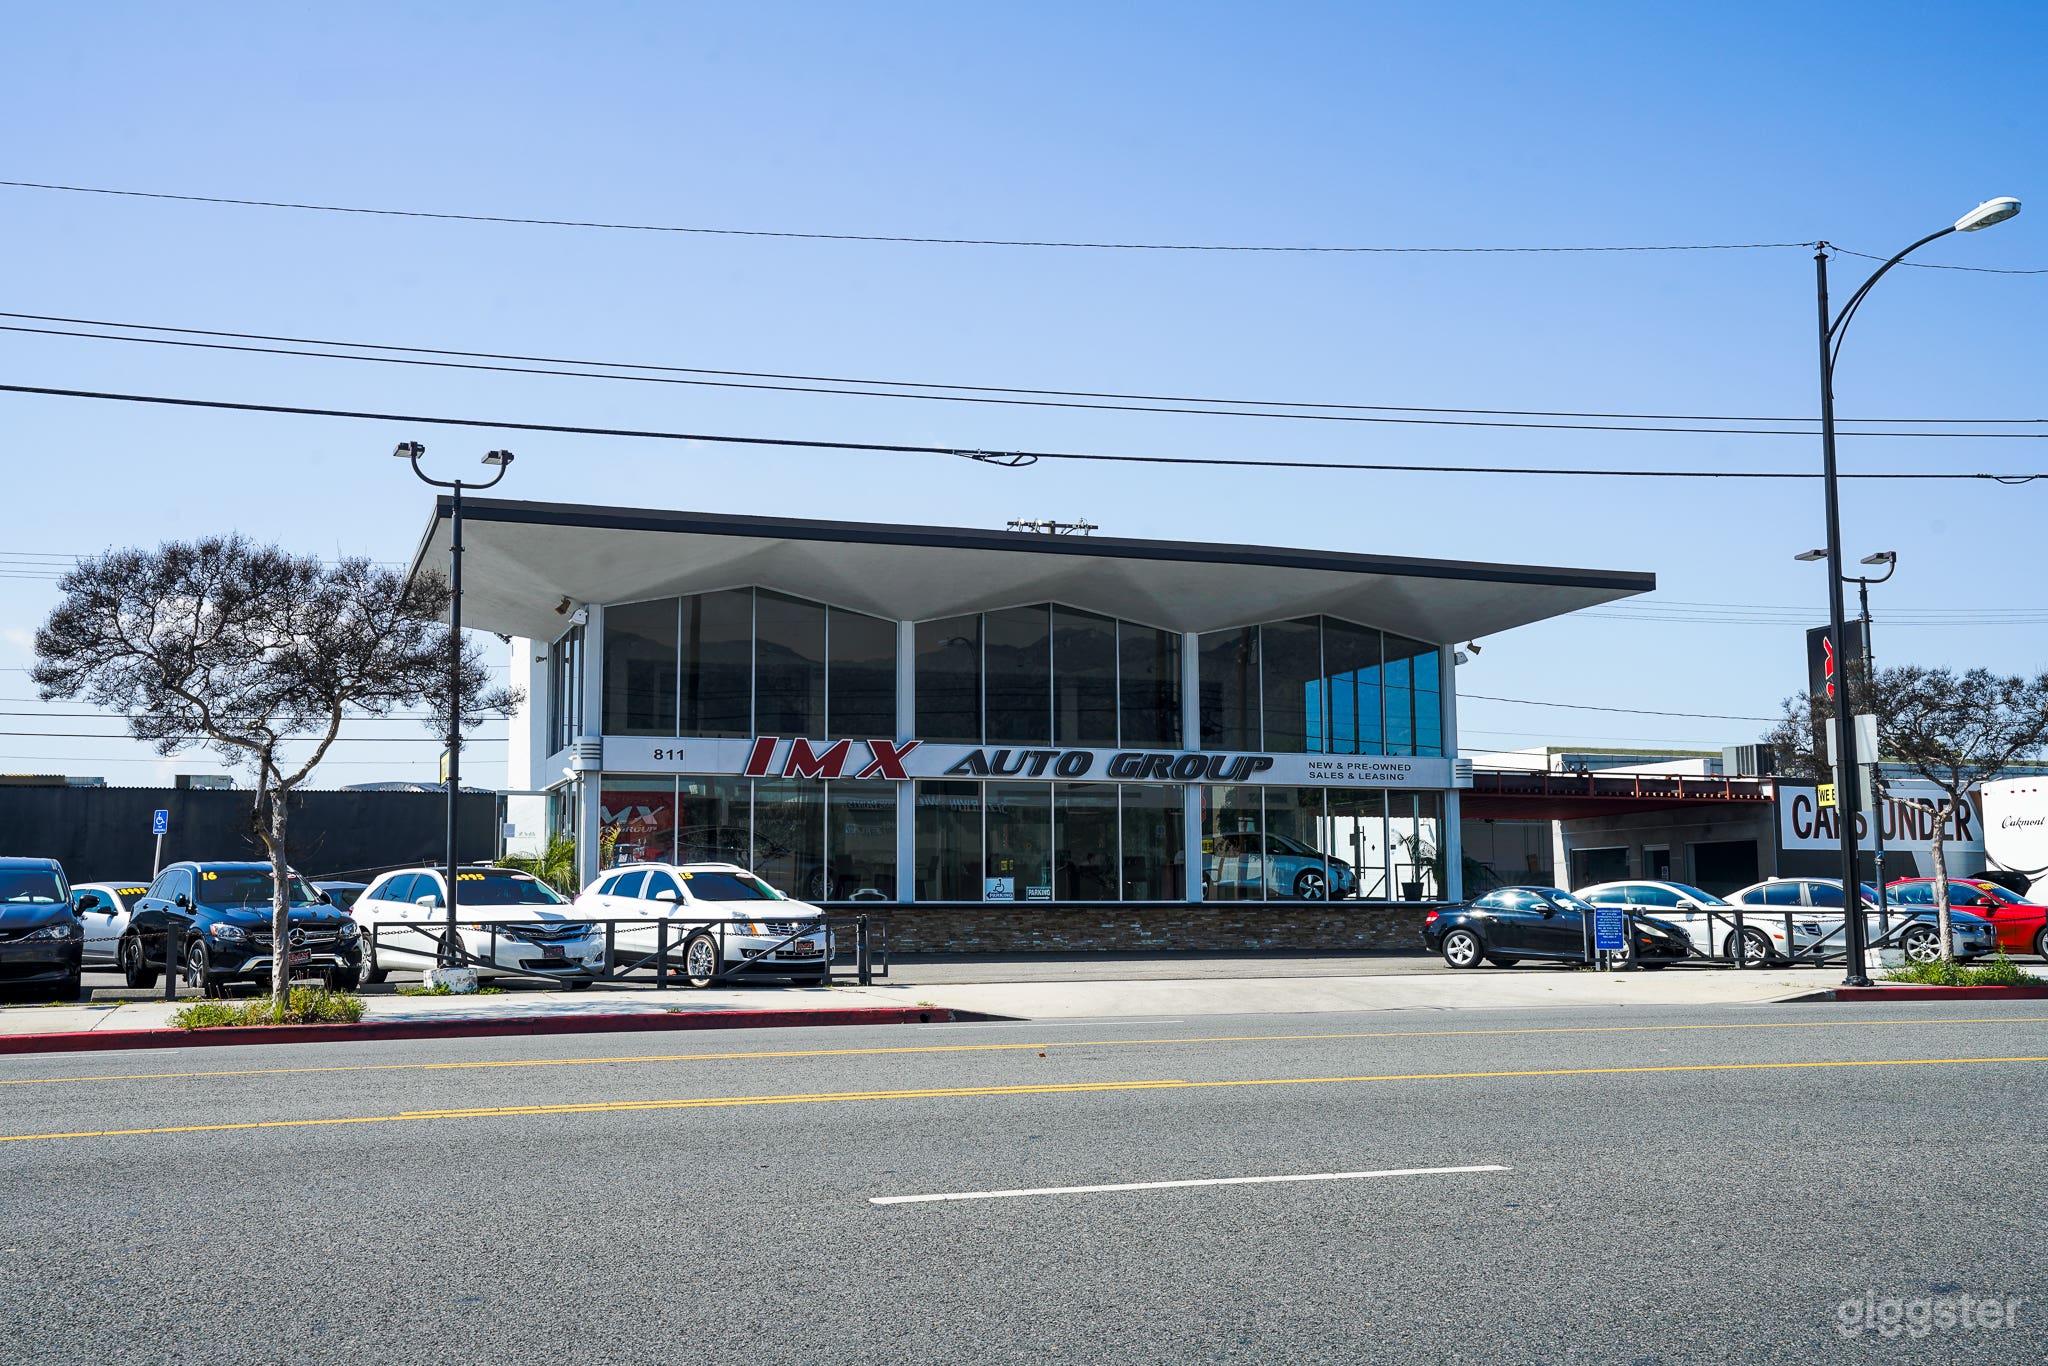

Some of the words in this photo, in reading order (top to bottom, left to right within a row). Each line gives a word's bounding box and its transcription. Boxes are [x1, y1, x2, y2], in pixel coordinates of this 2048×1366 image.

[653, 748, 685, 761] 811
[743, 736, 924, 781] IMX
[943, 749, 1094, 778] AUTO
[1106, 752, 1274, 782] GROUP
[1308, 762, 1333, 770] NEW
[1336, 762, 1344, 770] &
[1347, 762, 1412, 772] PRE-OWNED
[1309, 771, 1344, 780] SALES
[1347, 772, 1355, 780] &
[1358, 772, 1405, 781] LEASING
[1819, 789, 1830, 802] WE
[202, 871, 218, 881] 16
[680, 872, 694, 880] 15
